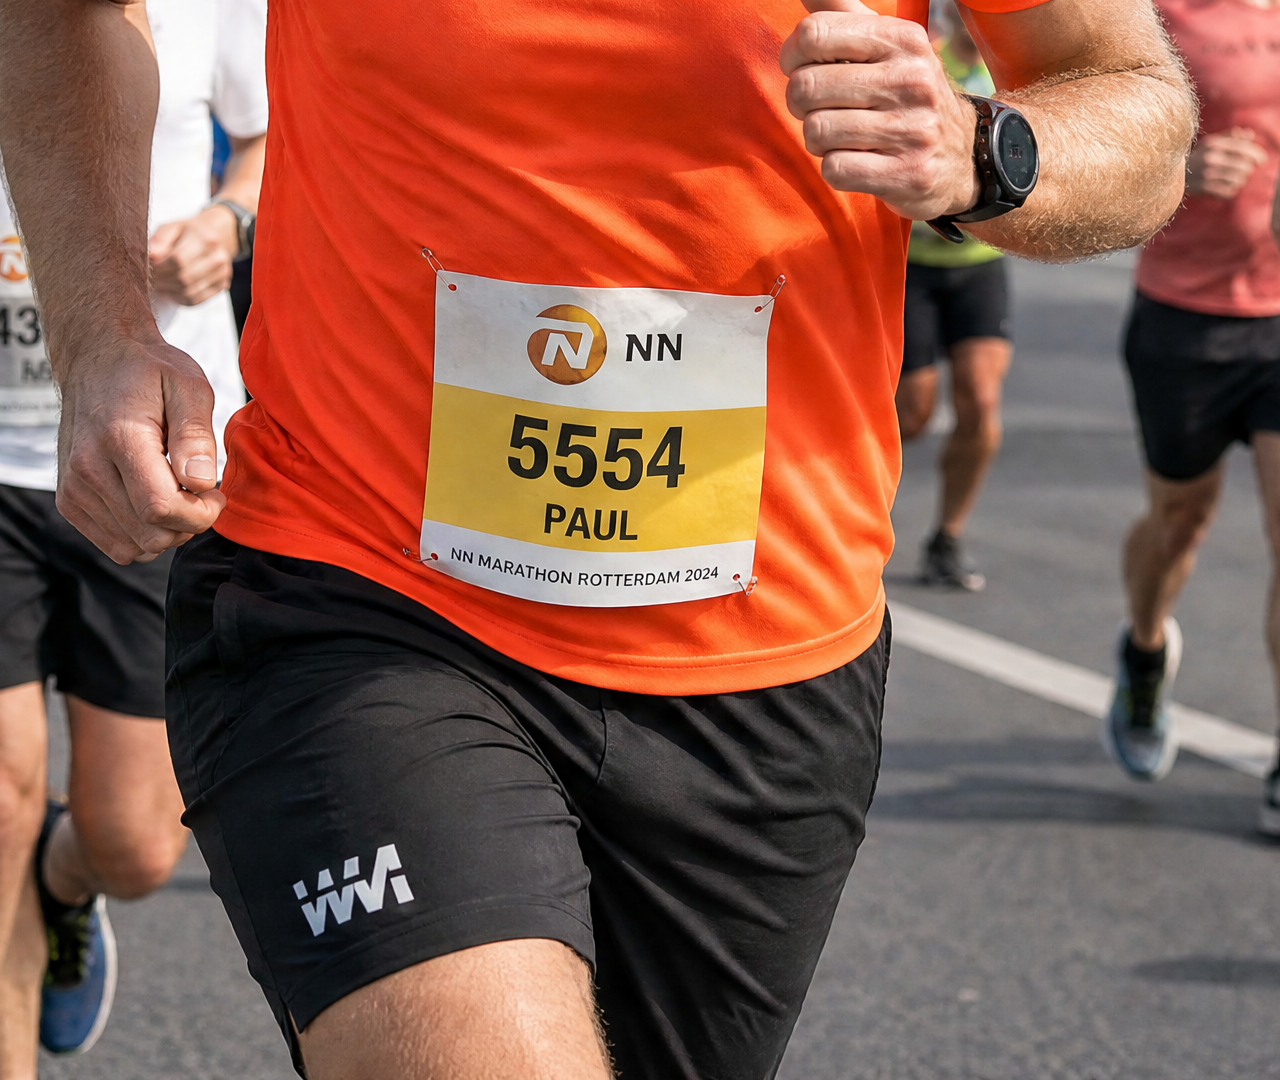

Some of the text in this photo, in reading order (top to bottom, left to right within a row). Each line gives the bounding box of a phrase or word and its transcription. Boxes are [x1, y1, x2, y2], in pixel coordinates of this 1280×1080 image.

[625, 333, 683, 362] NN
[507, 413, 686, 491] 5554
[543, 502, 638, 541] PAUL
[450, 547, 719, 587] NN MARATHON ROTTERDAM 2024
